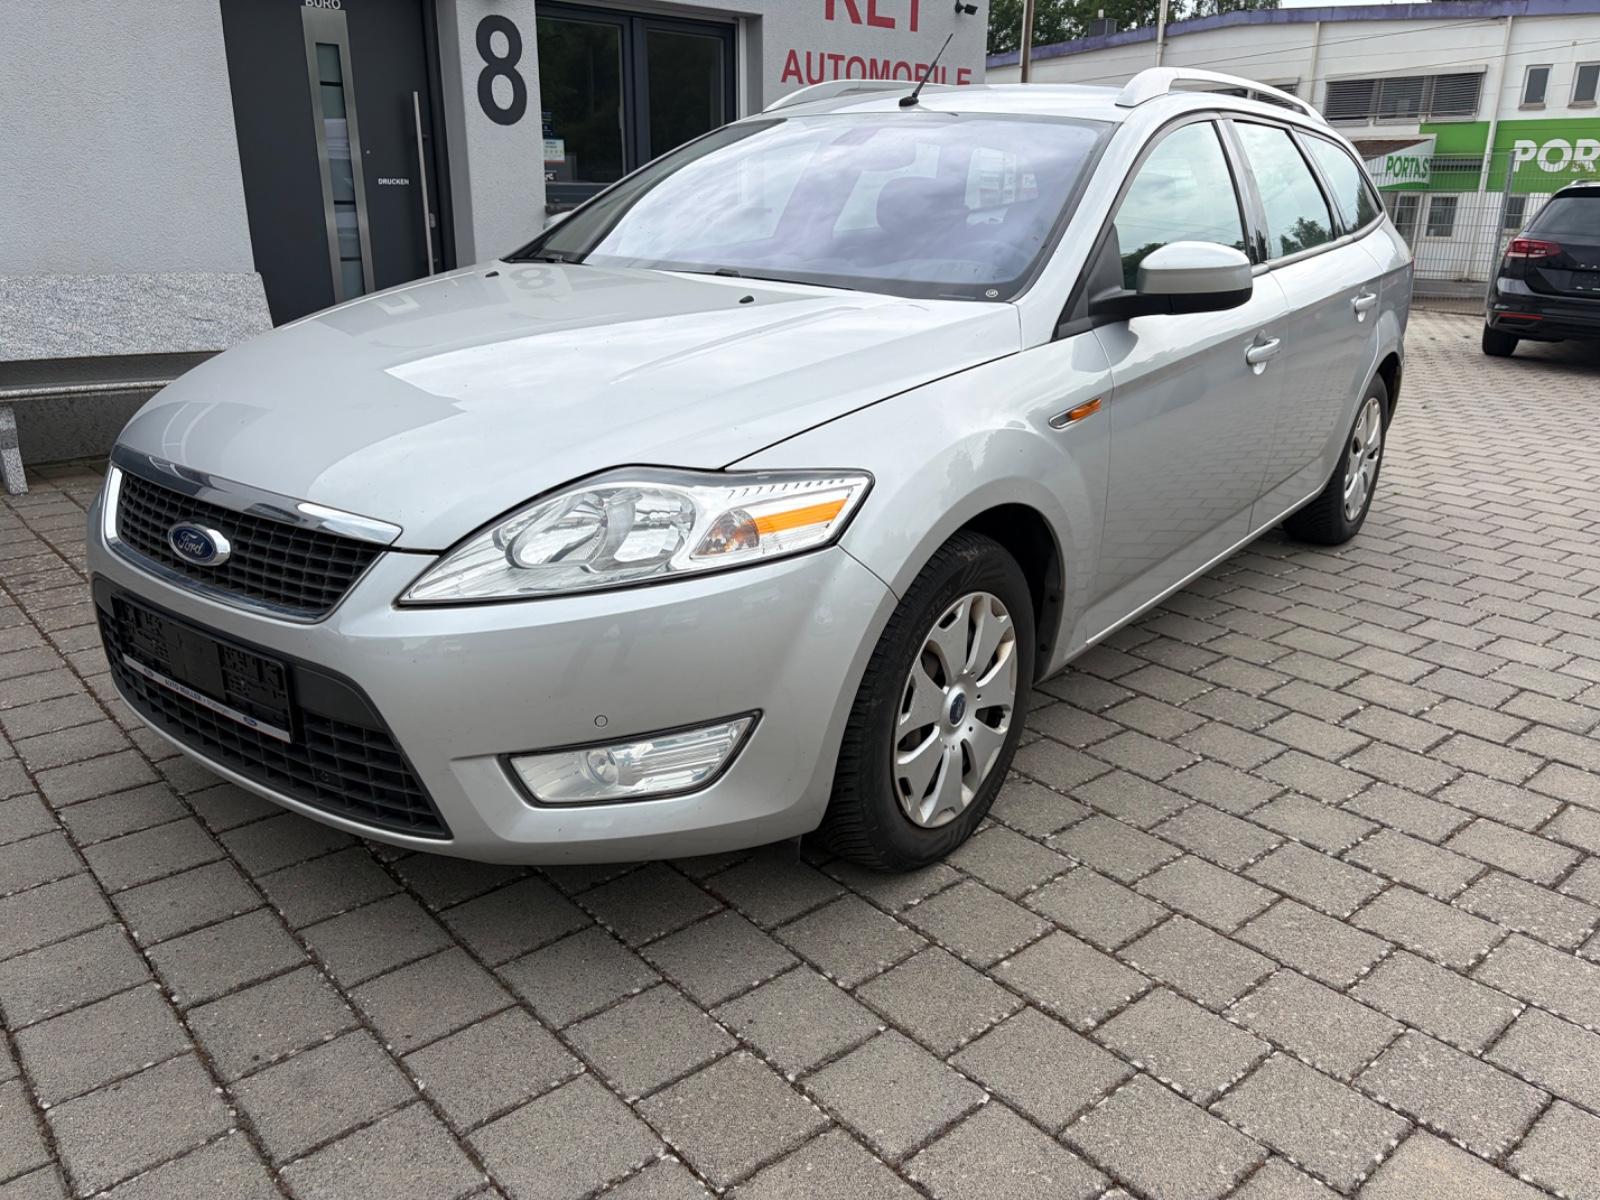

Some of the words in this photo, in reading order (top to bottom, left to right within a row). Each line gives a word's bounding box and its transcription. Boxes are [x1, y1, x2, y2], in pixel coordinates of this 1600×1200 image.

[476, 14, 527, 126] 8
[1385, 155, 1429, 178] PORTAS
[1513, 138, 1600, 172] POR
[178, 531, 204, 554] Ford
